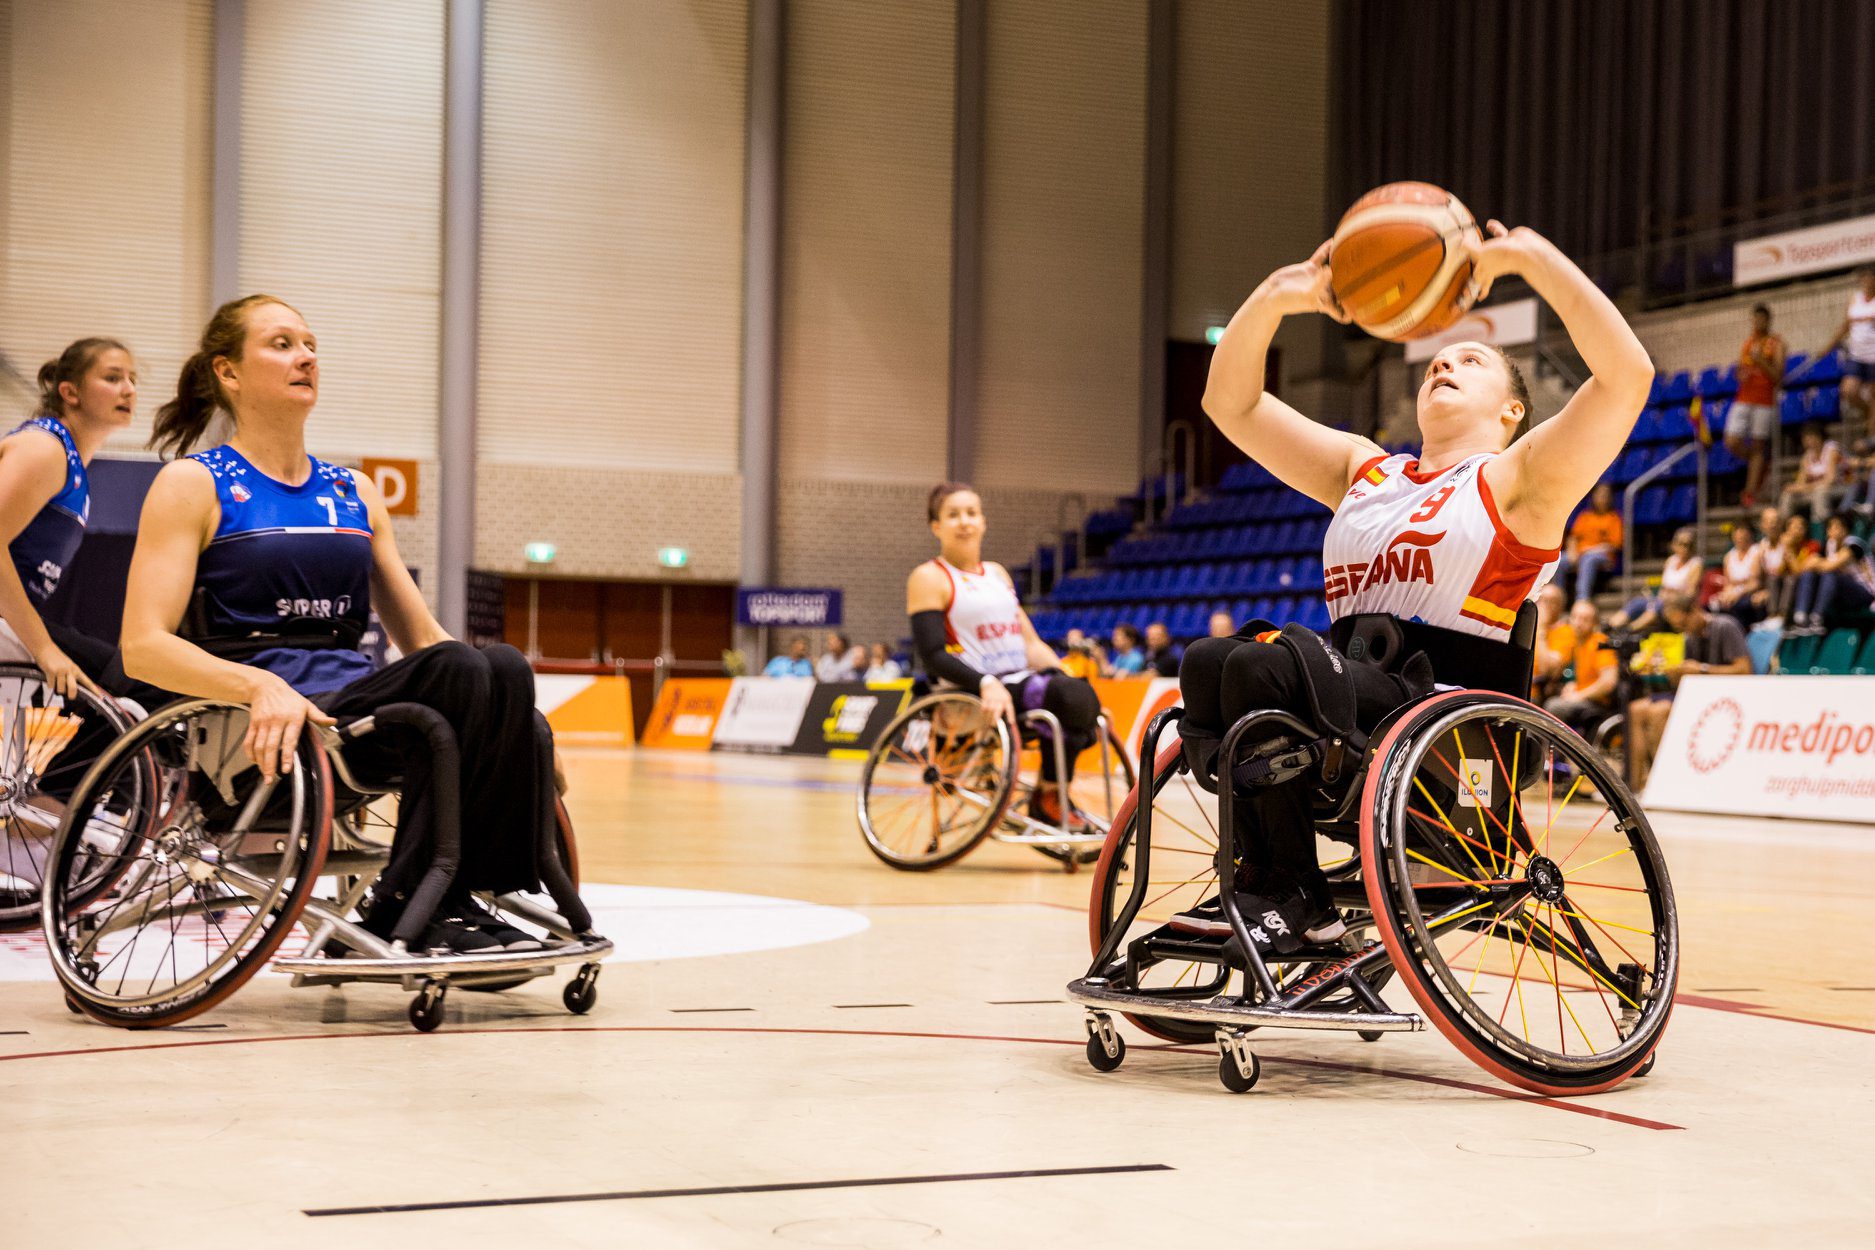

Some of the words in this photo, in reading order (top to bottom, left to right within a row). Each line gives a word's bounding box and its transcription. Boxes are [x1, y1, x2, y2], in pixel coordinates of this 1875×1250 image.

[373, 466, 407, 509] D
[1409, 485, 1456, 523] 9
[316, 496, 338, 526] 7
